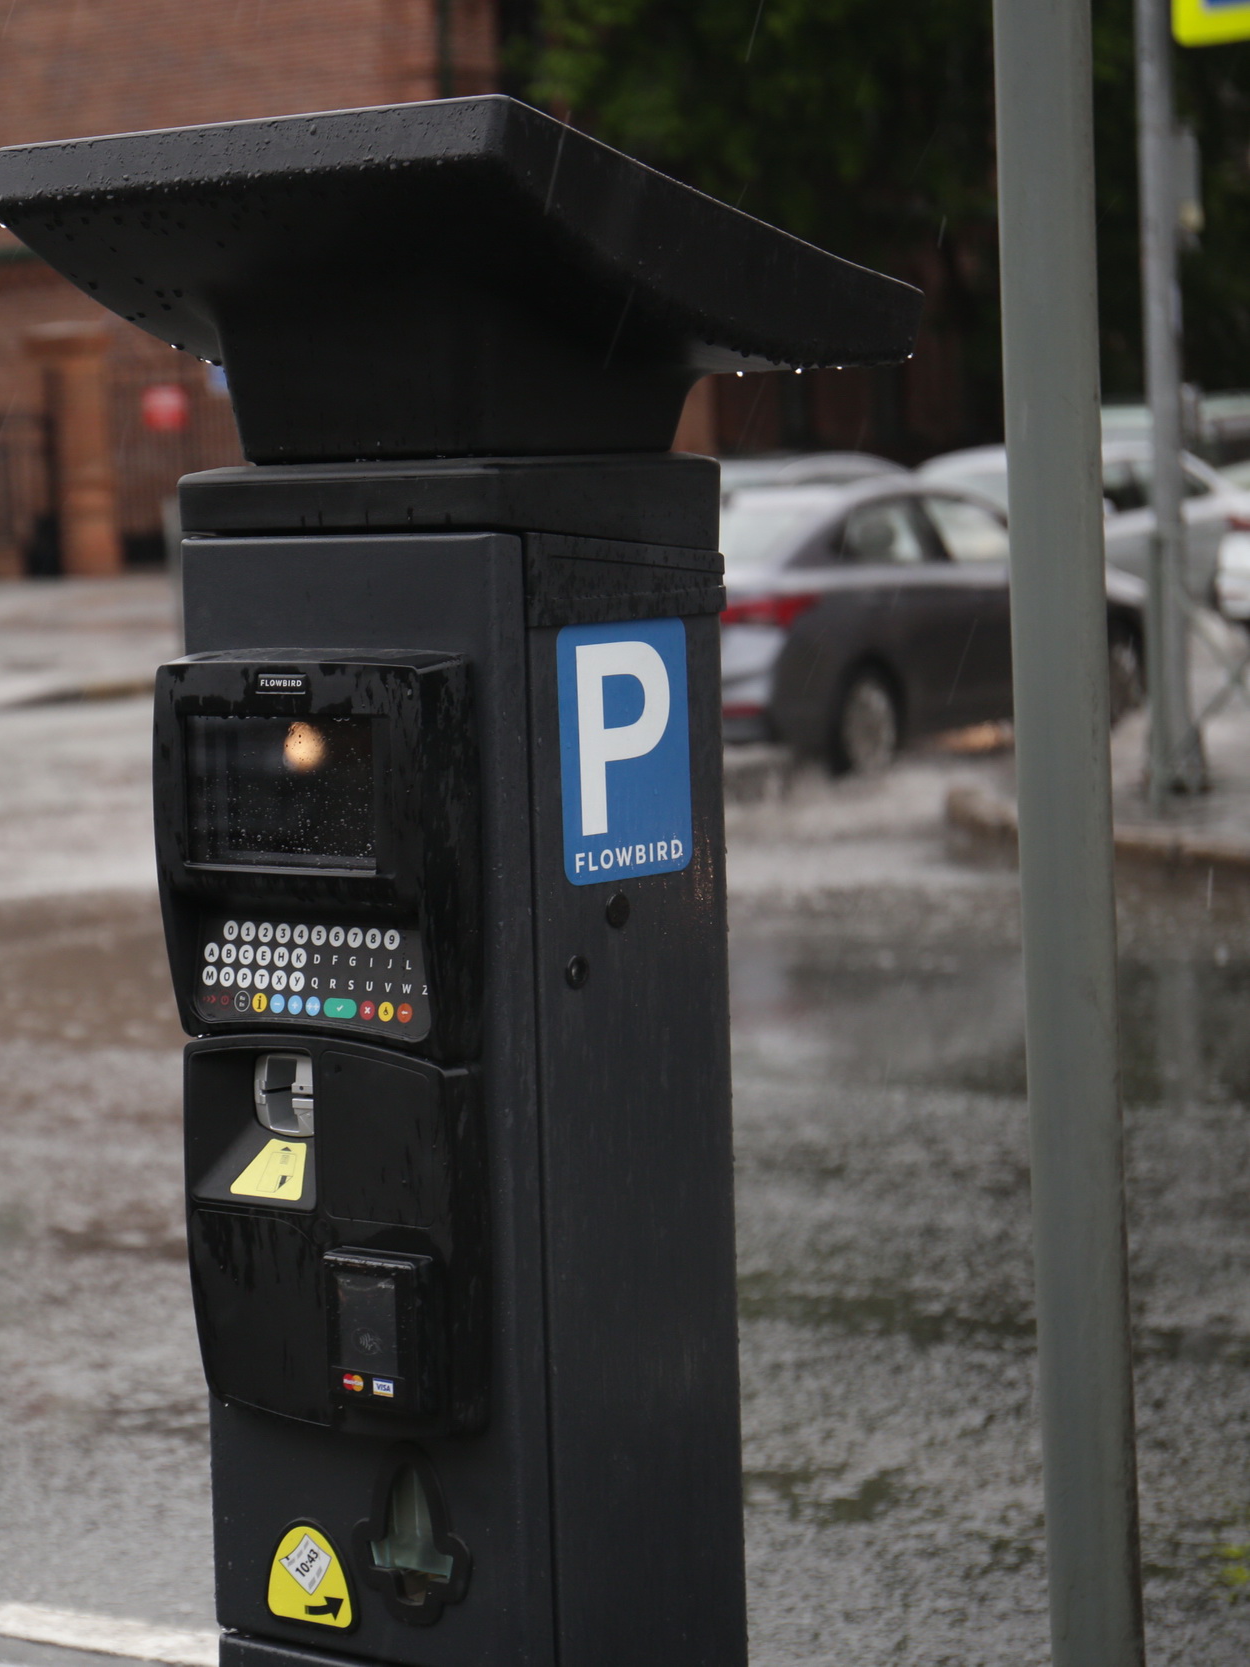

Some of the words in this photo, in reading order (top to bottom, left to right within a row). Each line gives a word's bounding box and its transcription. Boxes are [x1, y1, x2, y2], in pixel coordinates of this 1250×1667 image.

[260, 679, 302, 687] FLOWBIRD
[576, 641, 670, 836] P
[574, 839, 683, 874] FLOWBIRD
[246, 927, 250, 936] 1
[263, 928, 268, 937] 2
[281, 929, 286, 938] 3
[298, 930, 304, 939] 4
[316, 931, 322, 940] 5
[334, 932, 339, 941] 6
[352, 933, 358, 942] 7
[371, 934, 376, 943] 8
[389, 935, 395, 944] 9
[314, 955, 320, 963] D
[333, 955, 338, 965] F
[349, 957, 356, 966] G
[370, 958, 373, 967] I
[388, 959, 392, 968] J
[406, 960, 412, 970] L
[311, 978, 319, 989] Q
[330, 979, 336, 988] R
[348, 980, 354, 990] S
[366, 981, 373, 991] U
[385, 982, 392, 992] V
[402, 984, 411, 993] W
[377, 1383, 391, 1392] VISA
[295, 1549, 319, 1577] 10:43
